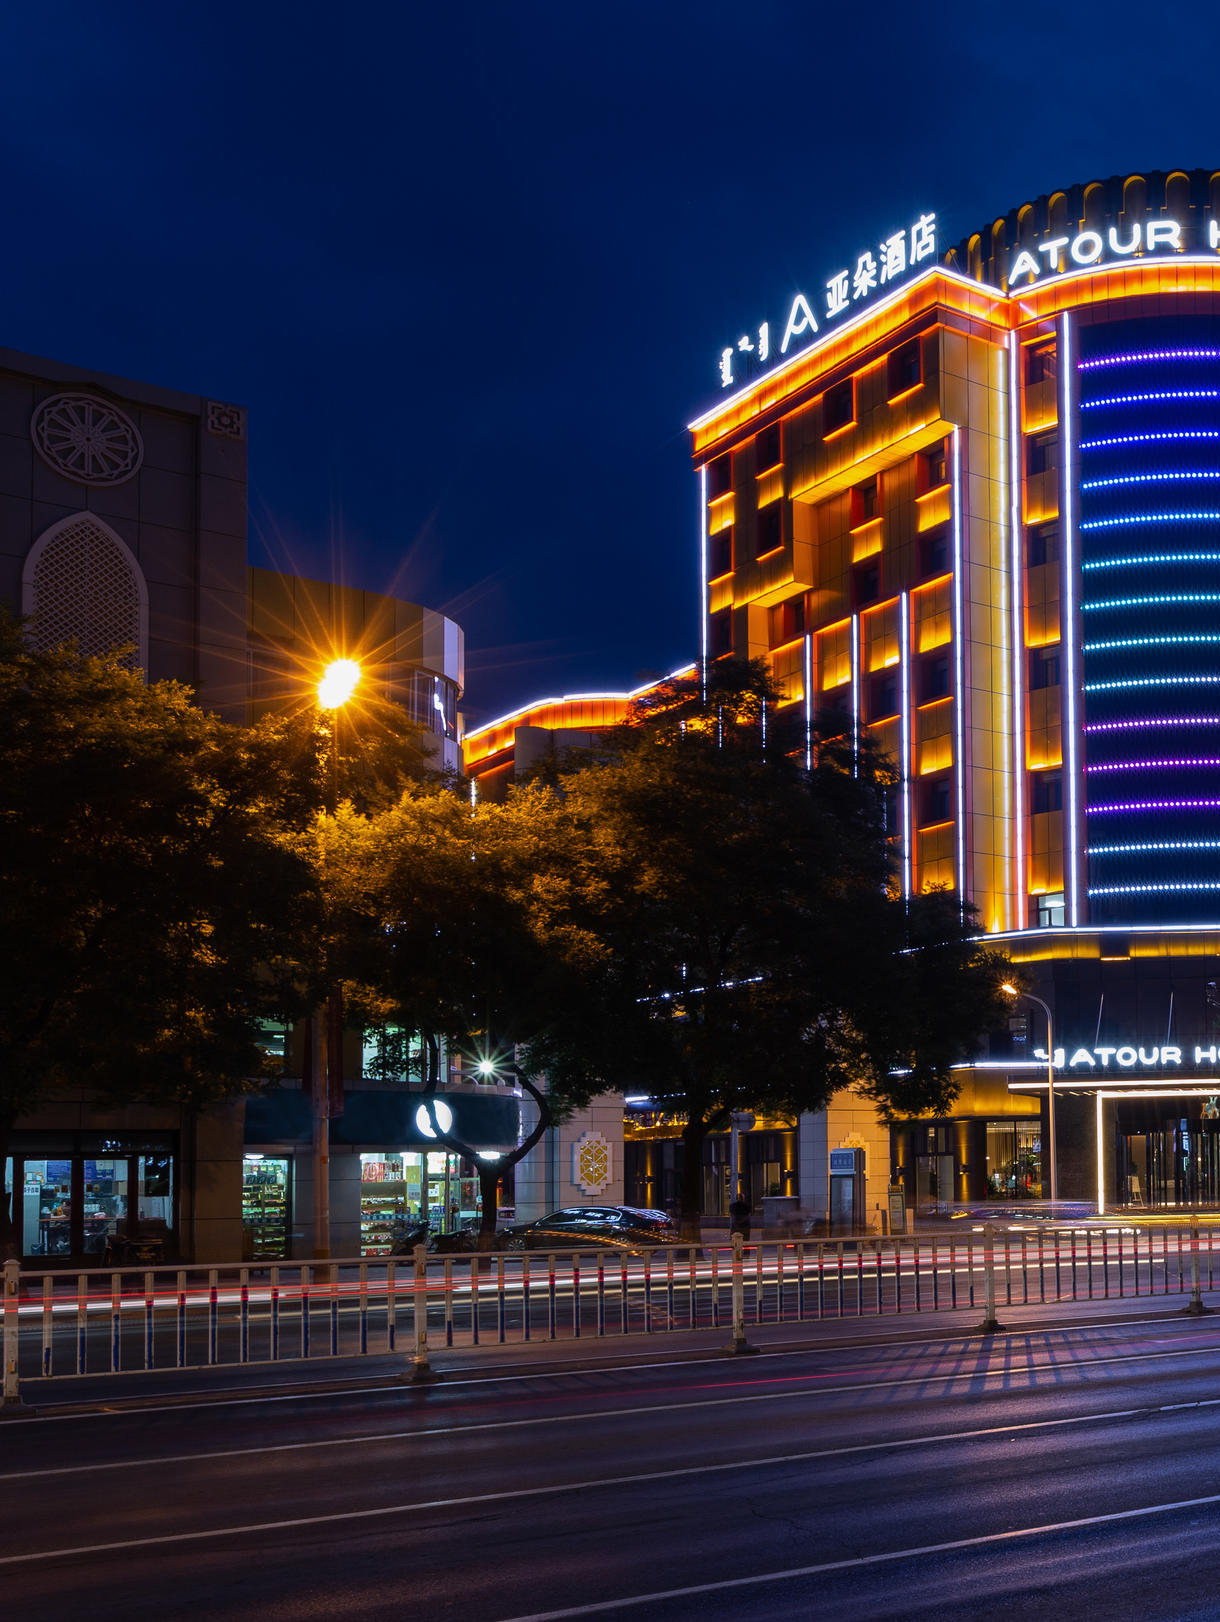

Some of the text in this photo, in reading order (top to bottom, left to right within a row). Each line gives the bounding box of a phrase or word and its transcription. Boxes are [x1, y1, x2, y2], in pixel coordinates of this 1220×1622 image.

[825, 212, 936, 319] 亚朵酒店
[1007, 219, 1184, 285] ATOUR
[1069, 1046, 1182, 1067] ATOUR
